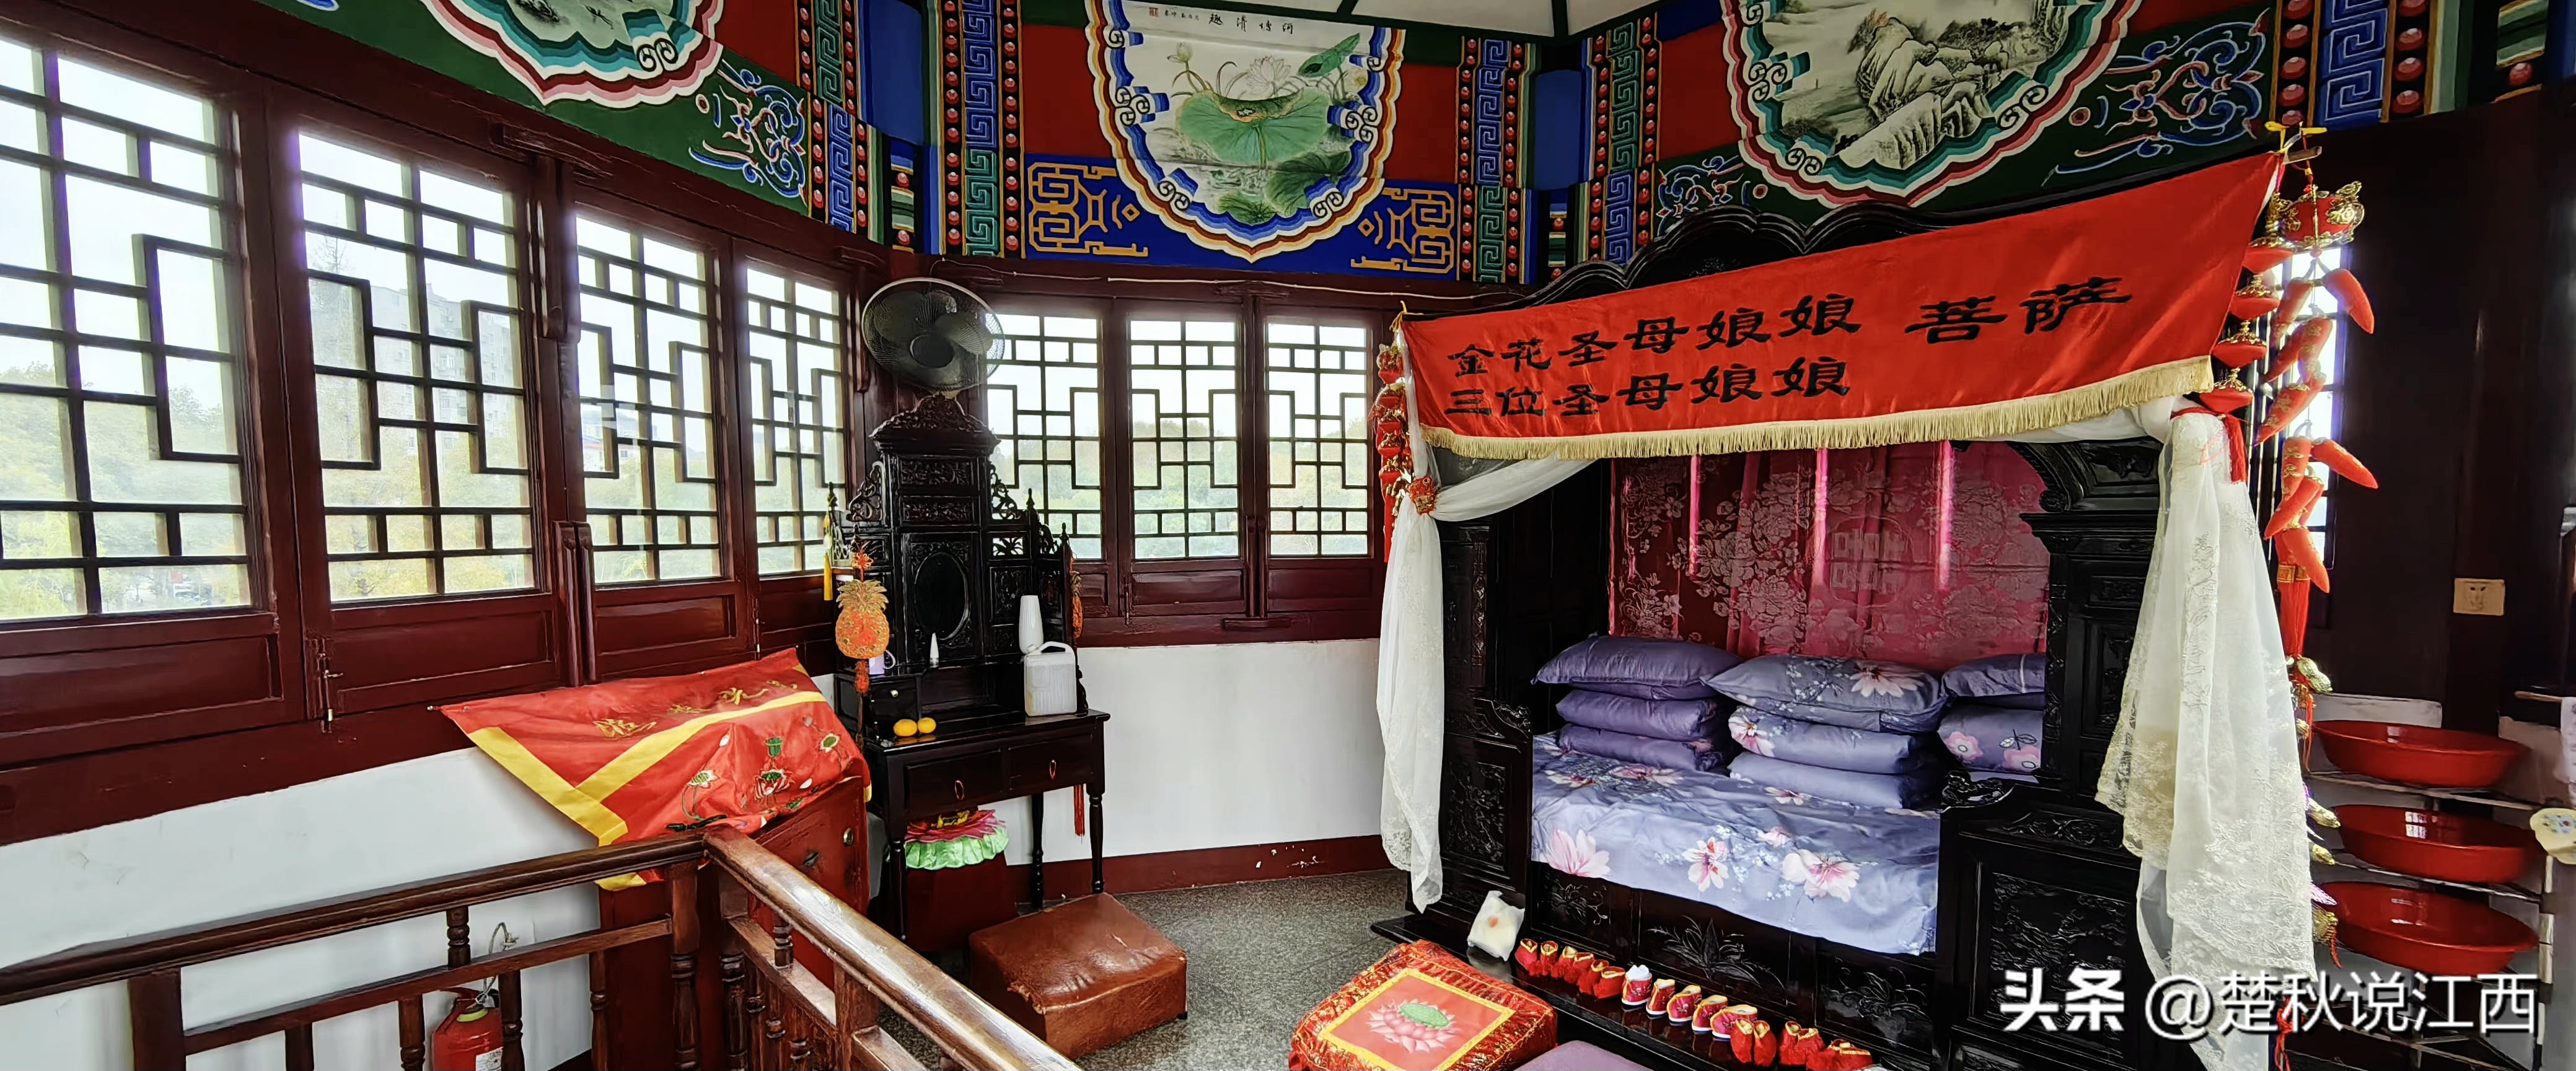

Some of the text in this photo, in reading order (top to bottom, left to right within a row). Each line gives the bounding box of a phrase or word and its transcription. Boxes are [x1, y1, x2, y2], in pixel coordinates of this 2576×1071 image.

[1447, 276, 2134, 378] 金花圣母娘娘 菩萨
[1444, 356, 1851, 417] 三位圣母娘娘
